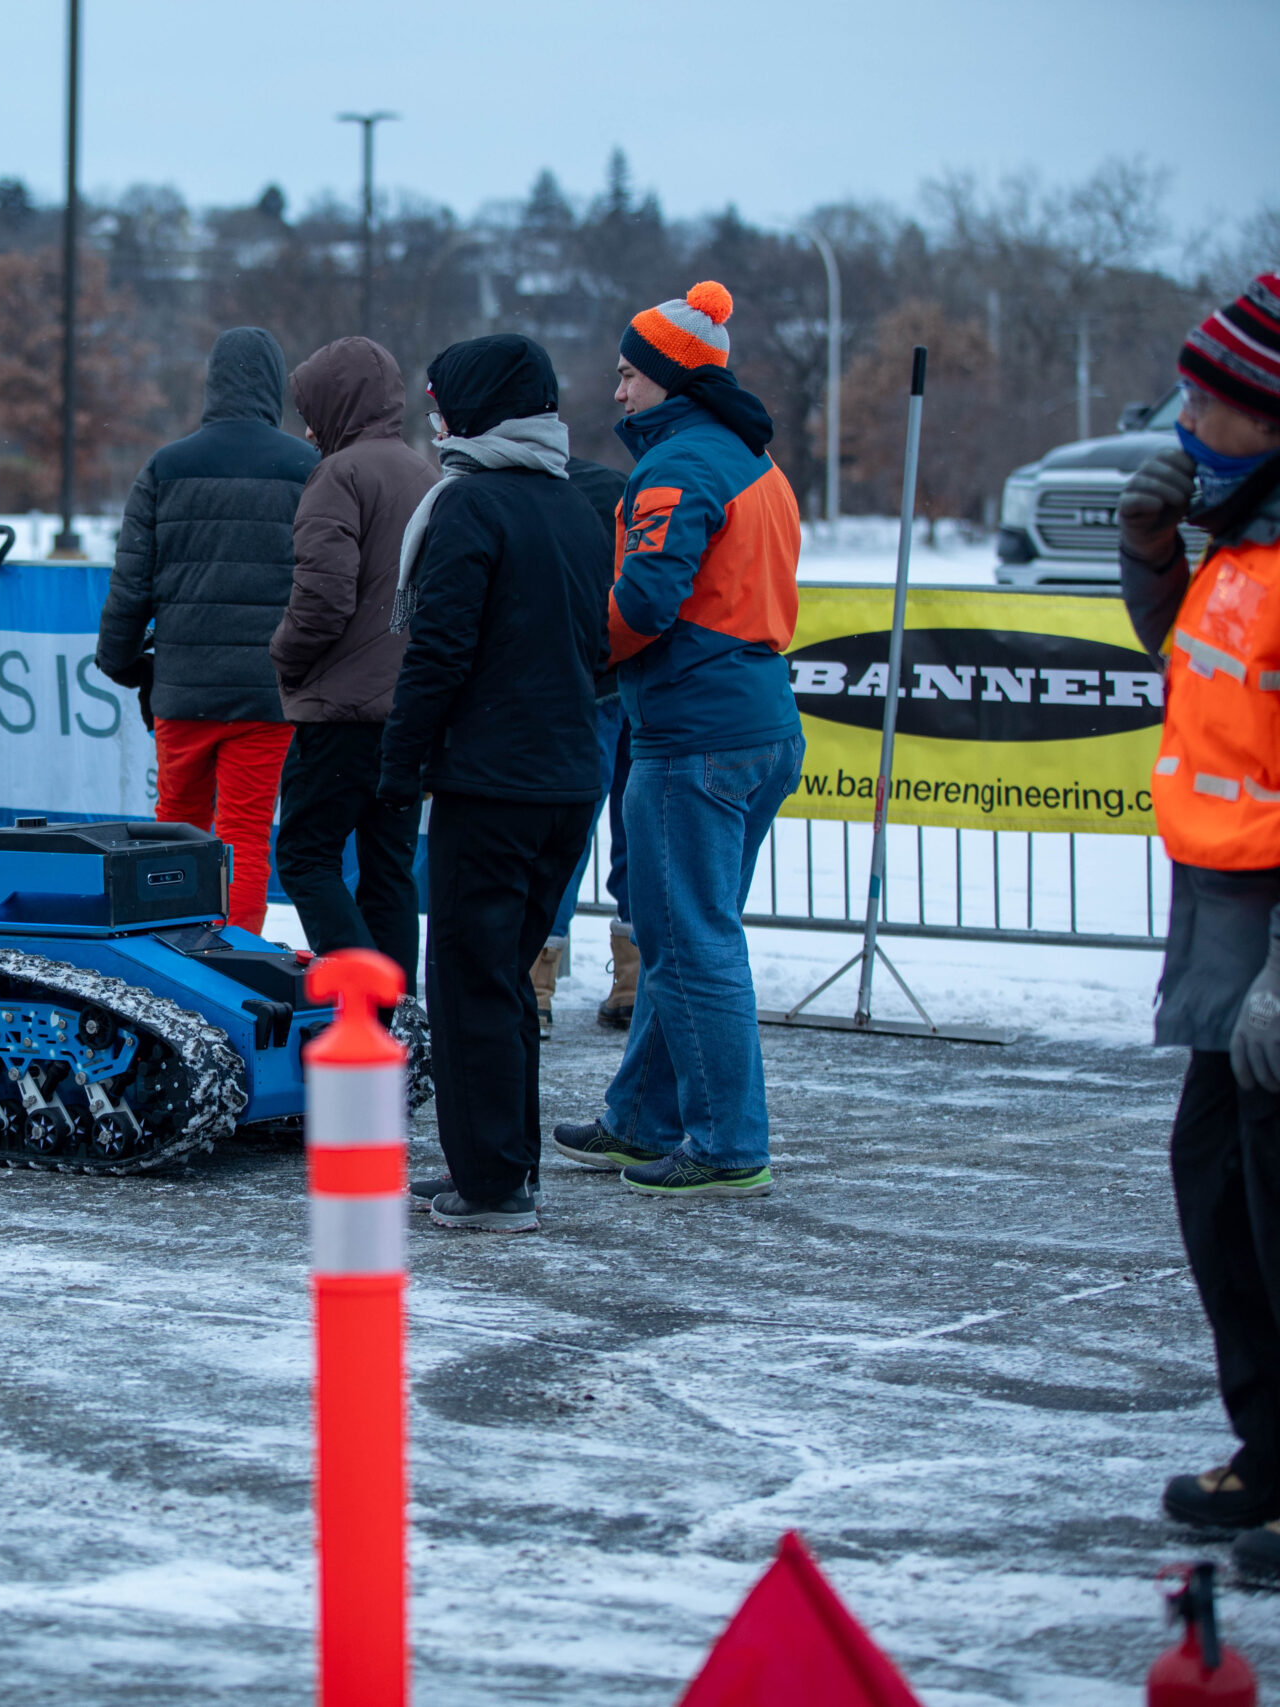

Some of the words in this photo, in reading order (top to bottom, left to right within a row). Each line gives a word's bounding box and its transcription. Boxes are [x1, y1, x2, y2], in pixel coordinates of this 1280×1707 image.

[56, 650, 122, 739] IS
[789, 660, 1164, 707] BANNER
[797, 768, 1153, 818] w.banerengineering.c
